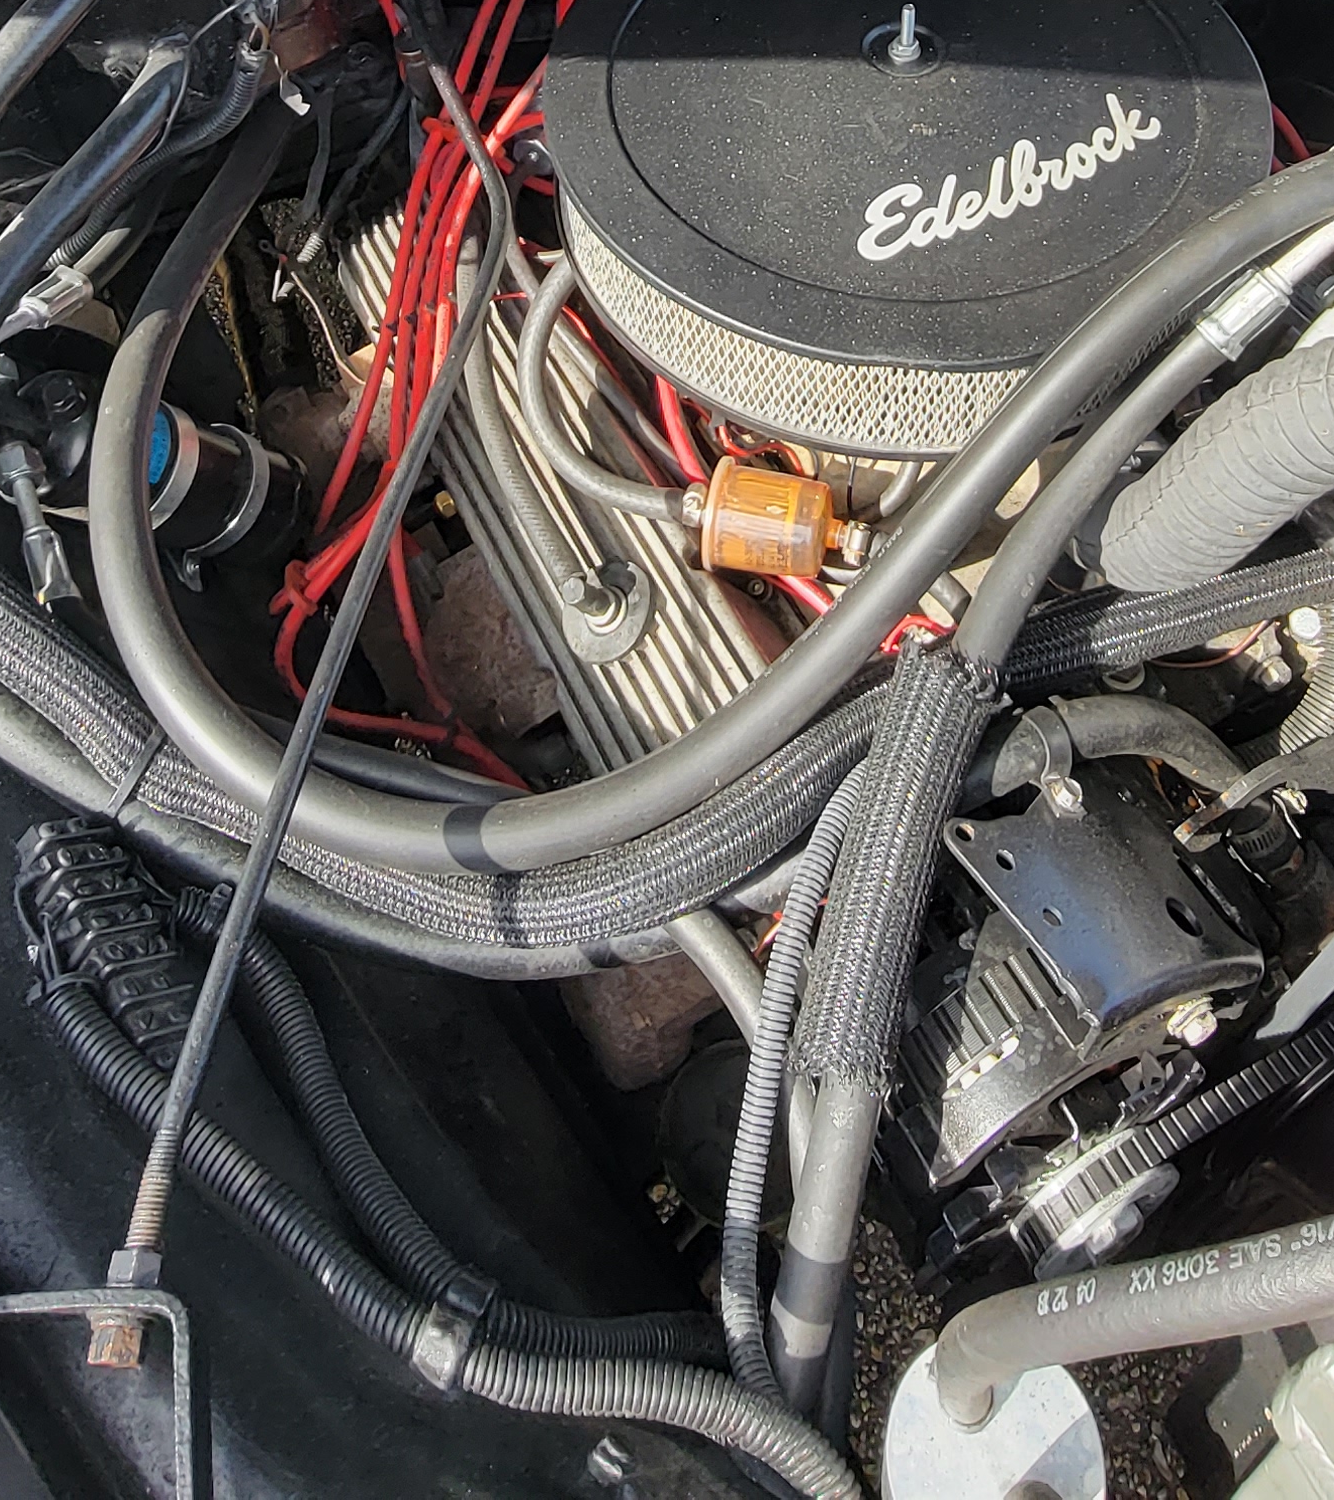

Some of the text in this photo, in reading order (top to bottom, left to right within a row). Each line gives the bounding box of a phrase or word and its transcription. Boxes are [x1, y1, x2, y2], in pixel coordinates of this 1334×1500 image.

[857, 93, 1162, 261] Edelbrock
[1229, 1233, 1283, 1270] SAE
[1128, 1264, 1158, 1296] KX
